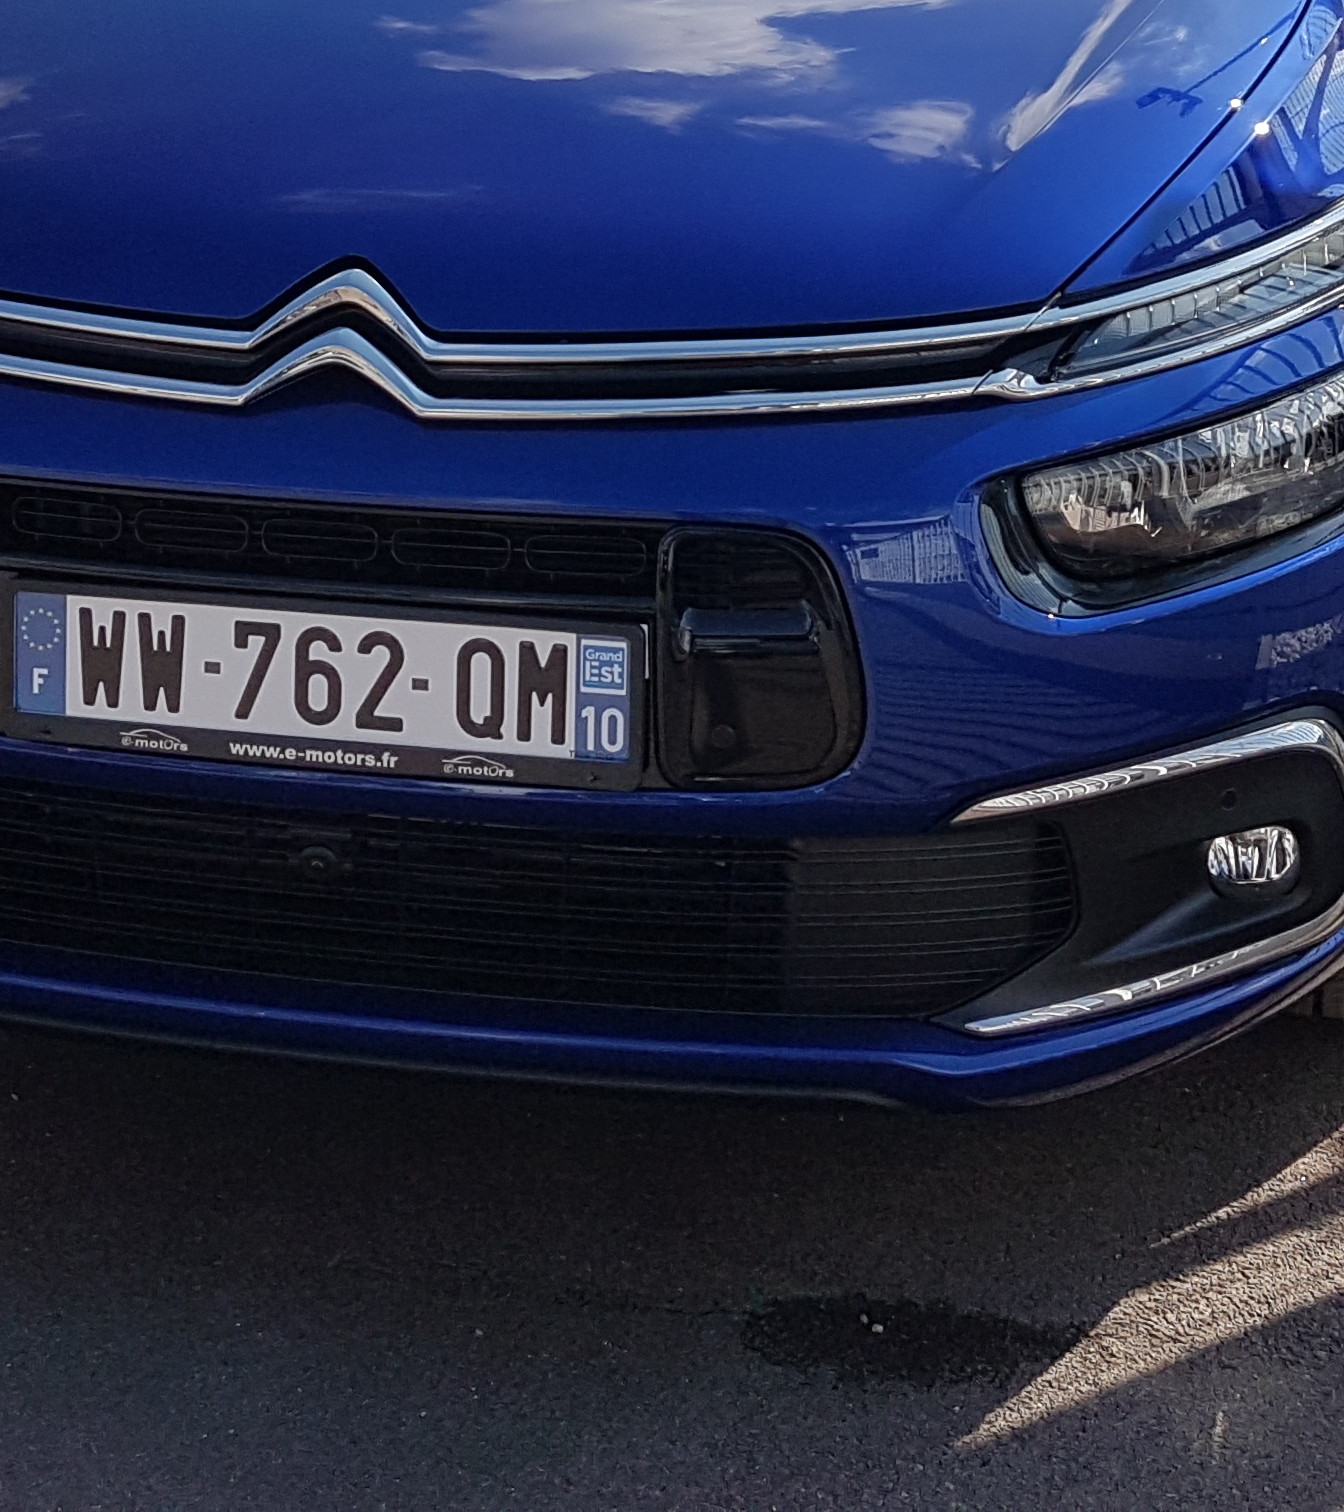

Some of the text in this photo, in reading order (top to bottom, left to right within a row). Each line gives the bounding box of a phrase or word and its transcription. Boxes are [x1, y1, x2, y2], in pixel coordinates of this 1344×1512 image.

[585, 648, 623, 662] Grand
[32, 667, 49, 694] F
[78, 606, 569, 746] WW-762-QM
[584, 661, 623, 684] Est
[581, 705, 625, 753] 10
[229, 742, 400, 769] www.e-motors.fr
